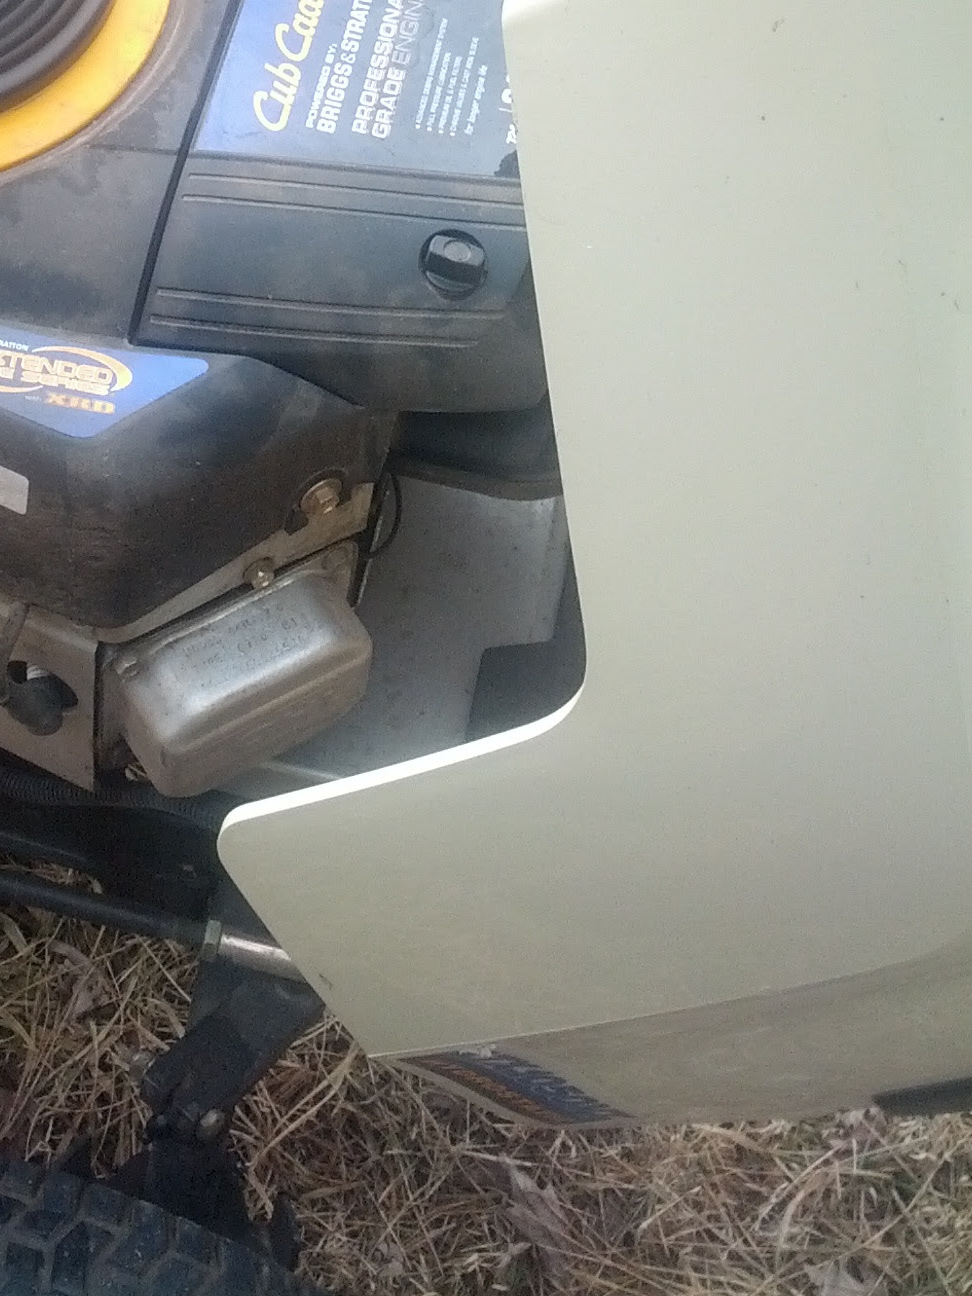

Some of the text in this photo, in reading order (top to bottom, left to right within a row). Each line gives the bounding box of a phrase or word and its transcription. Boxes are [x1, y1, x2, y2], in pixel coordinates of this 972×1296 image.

[253, 62, 301, 132] Cub
[306, 65, 330, 128] POWERED
[372, 67, 406, 139] GRADE
